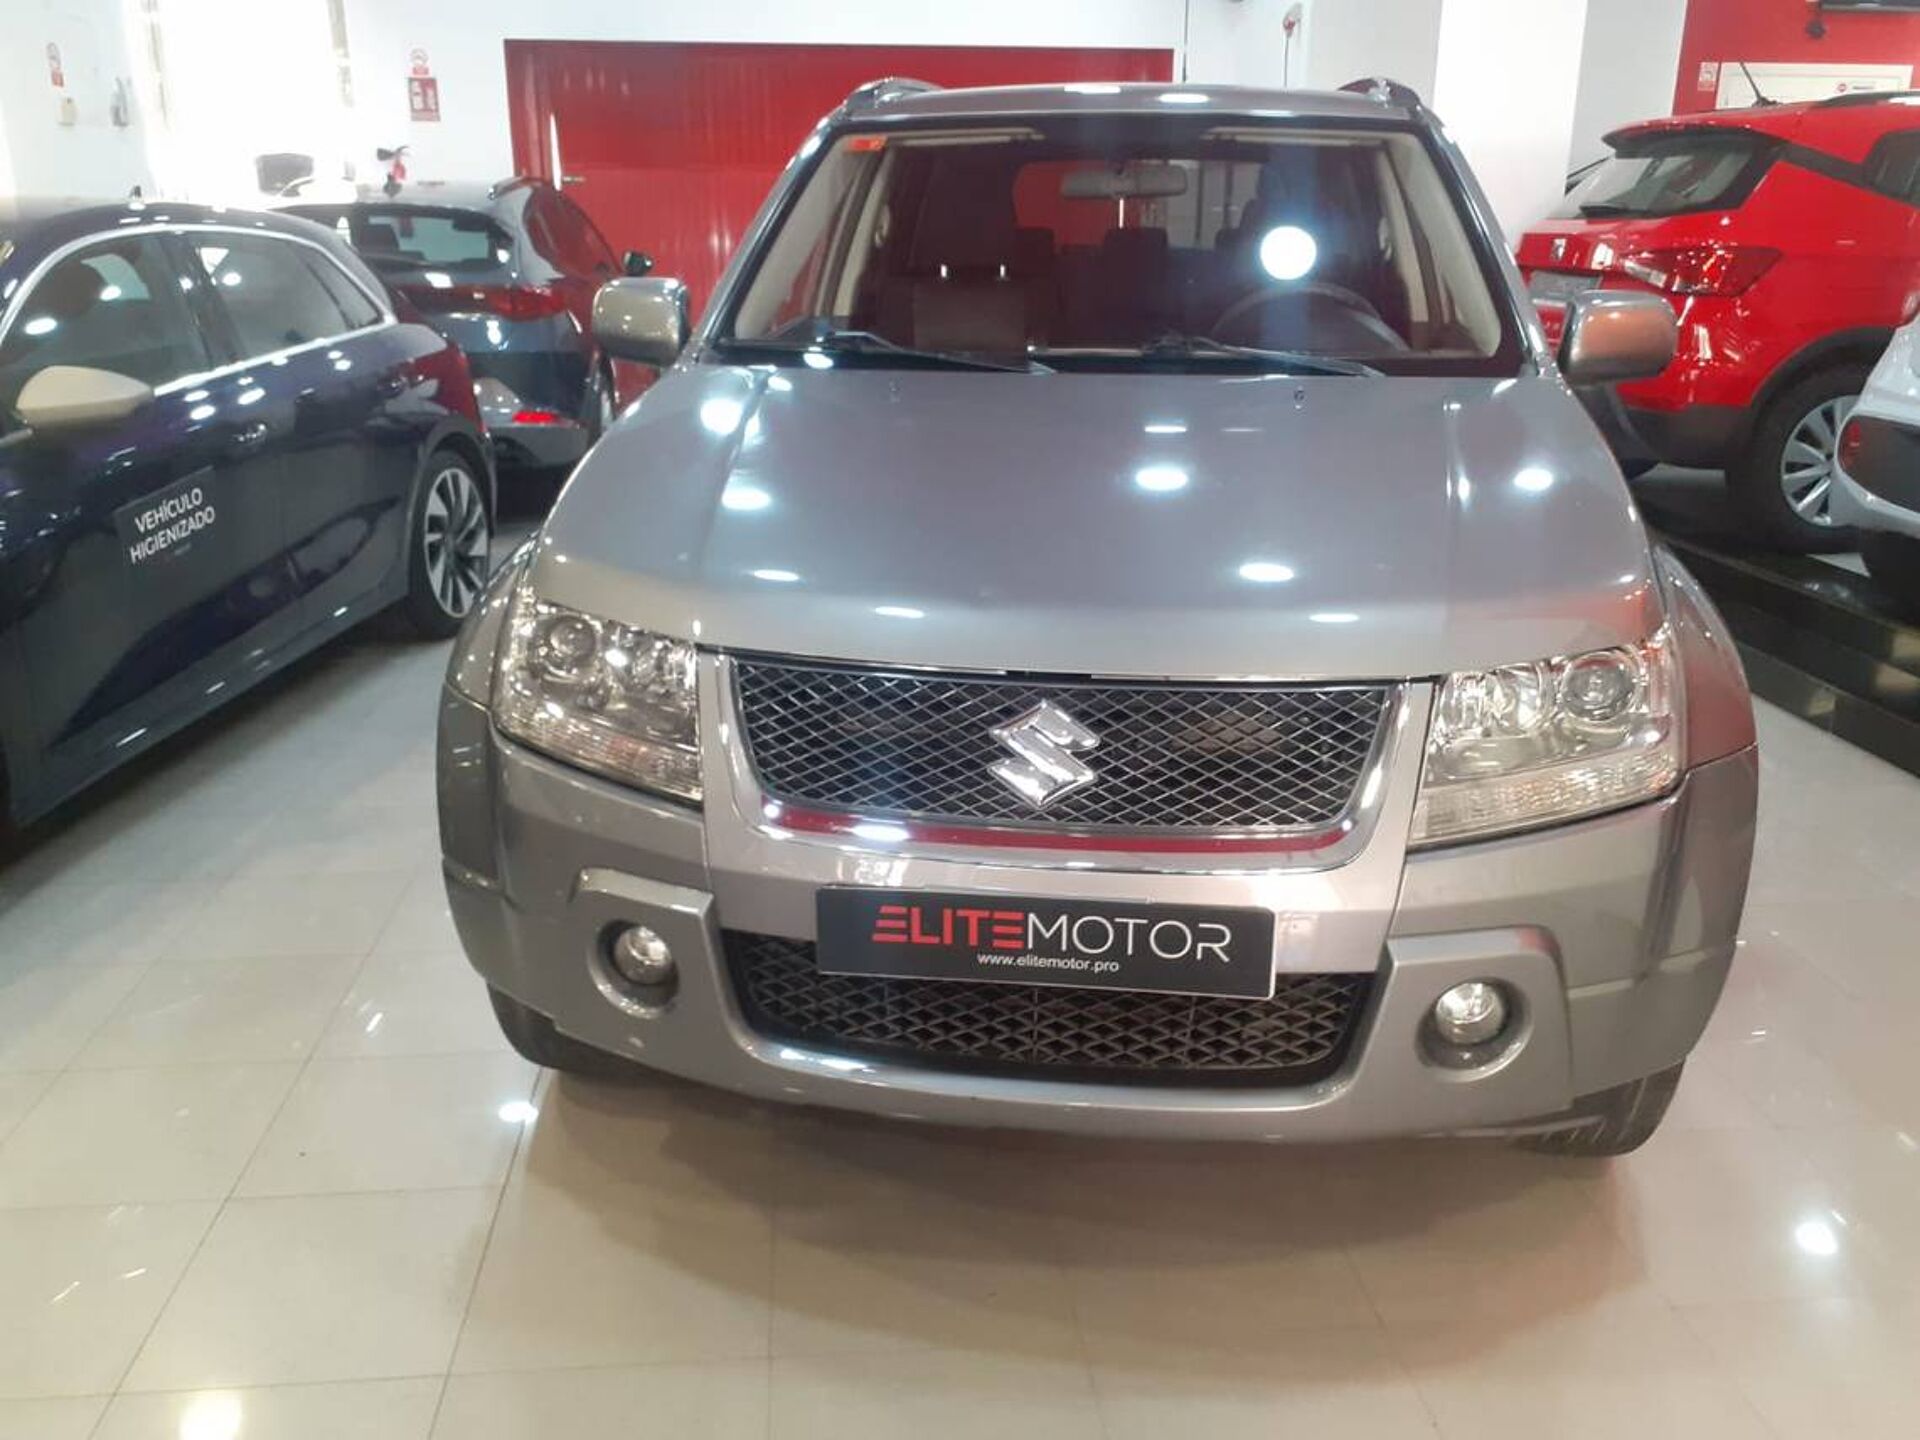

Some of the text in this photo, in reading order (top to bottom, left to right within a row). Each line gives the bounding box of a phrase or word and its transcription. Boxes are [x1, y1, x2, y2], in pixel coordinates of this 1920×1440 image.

[129, 506, 216, 564] HIGIENIZADO
[134, 487, 203, 533] VEHÍCULO
[871, 905, 1232, 963] ELITEMOTOR
[976, 952, 1120, 974] www.elitemotor.pro
